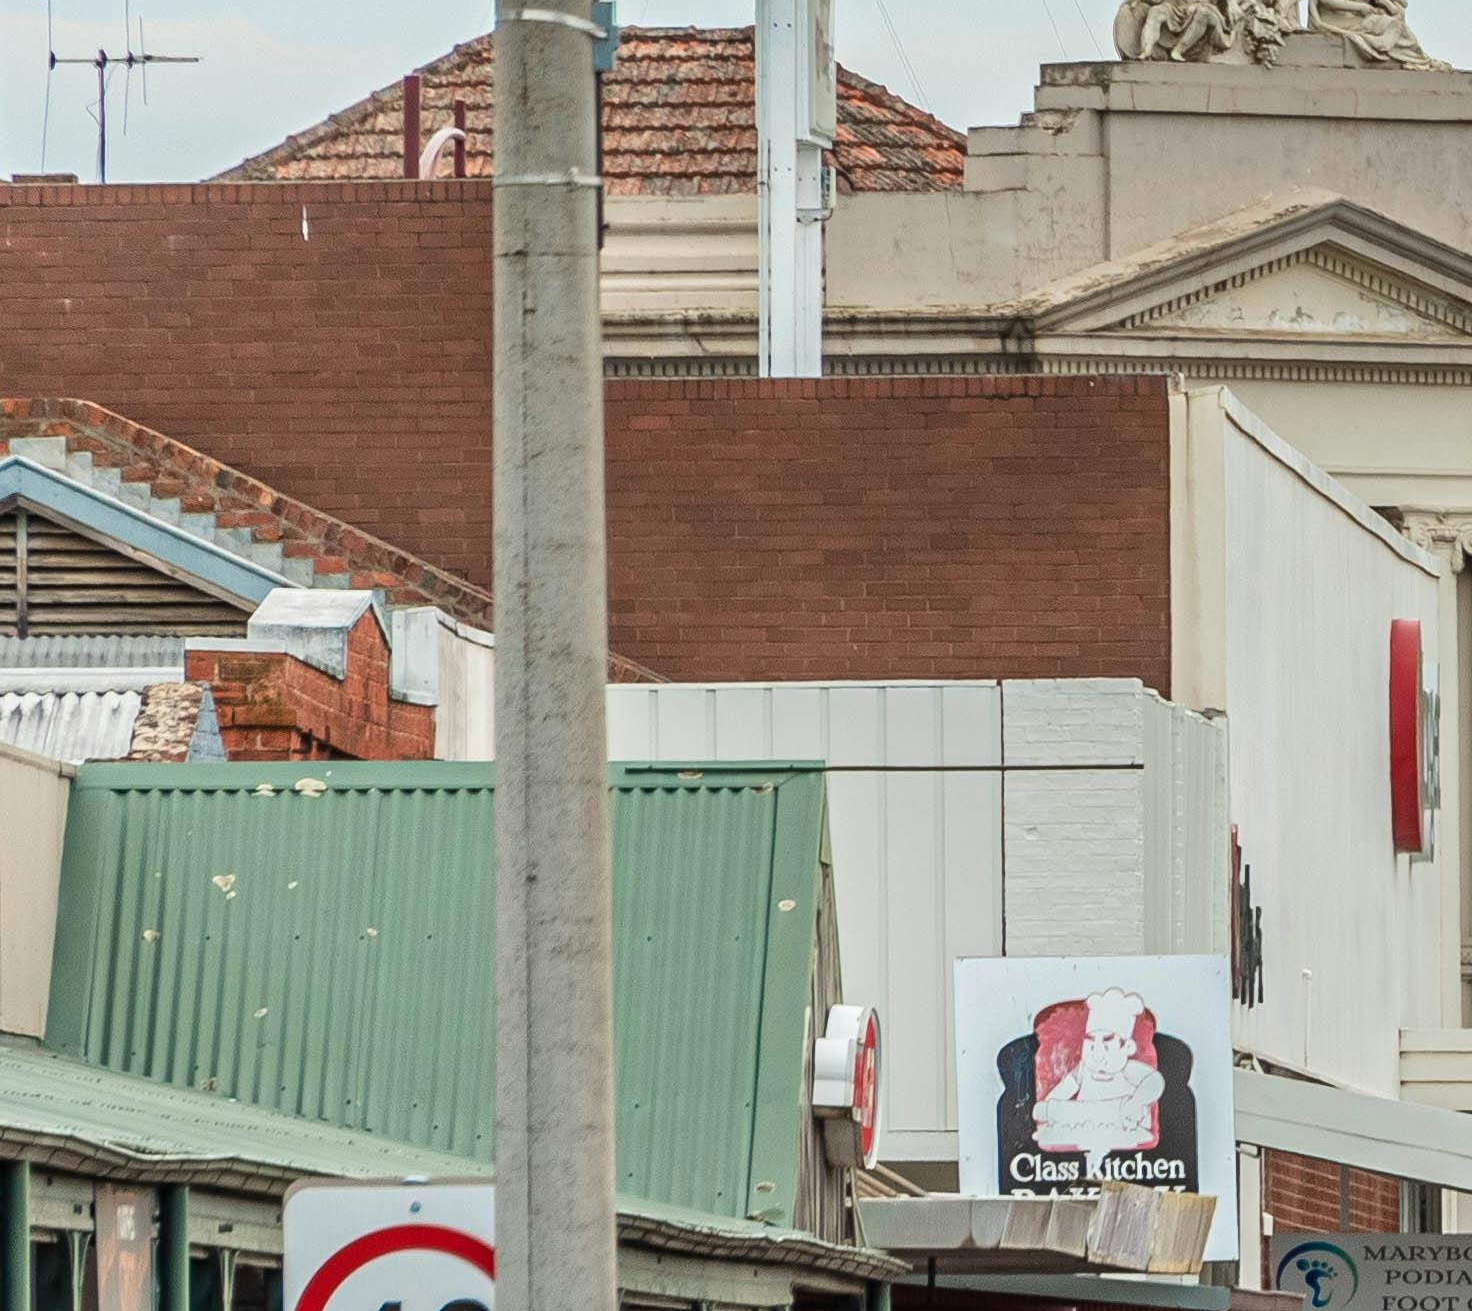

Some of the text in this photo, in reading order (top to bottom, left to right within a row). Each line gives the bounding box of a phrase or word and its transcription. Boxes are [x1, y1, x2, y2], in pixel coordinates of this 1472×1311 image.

[1010, 1151, 1186, 1182] Class Kitchen
[1382, 1295, 1459, 1311] FOOT
